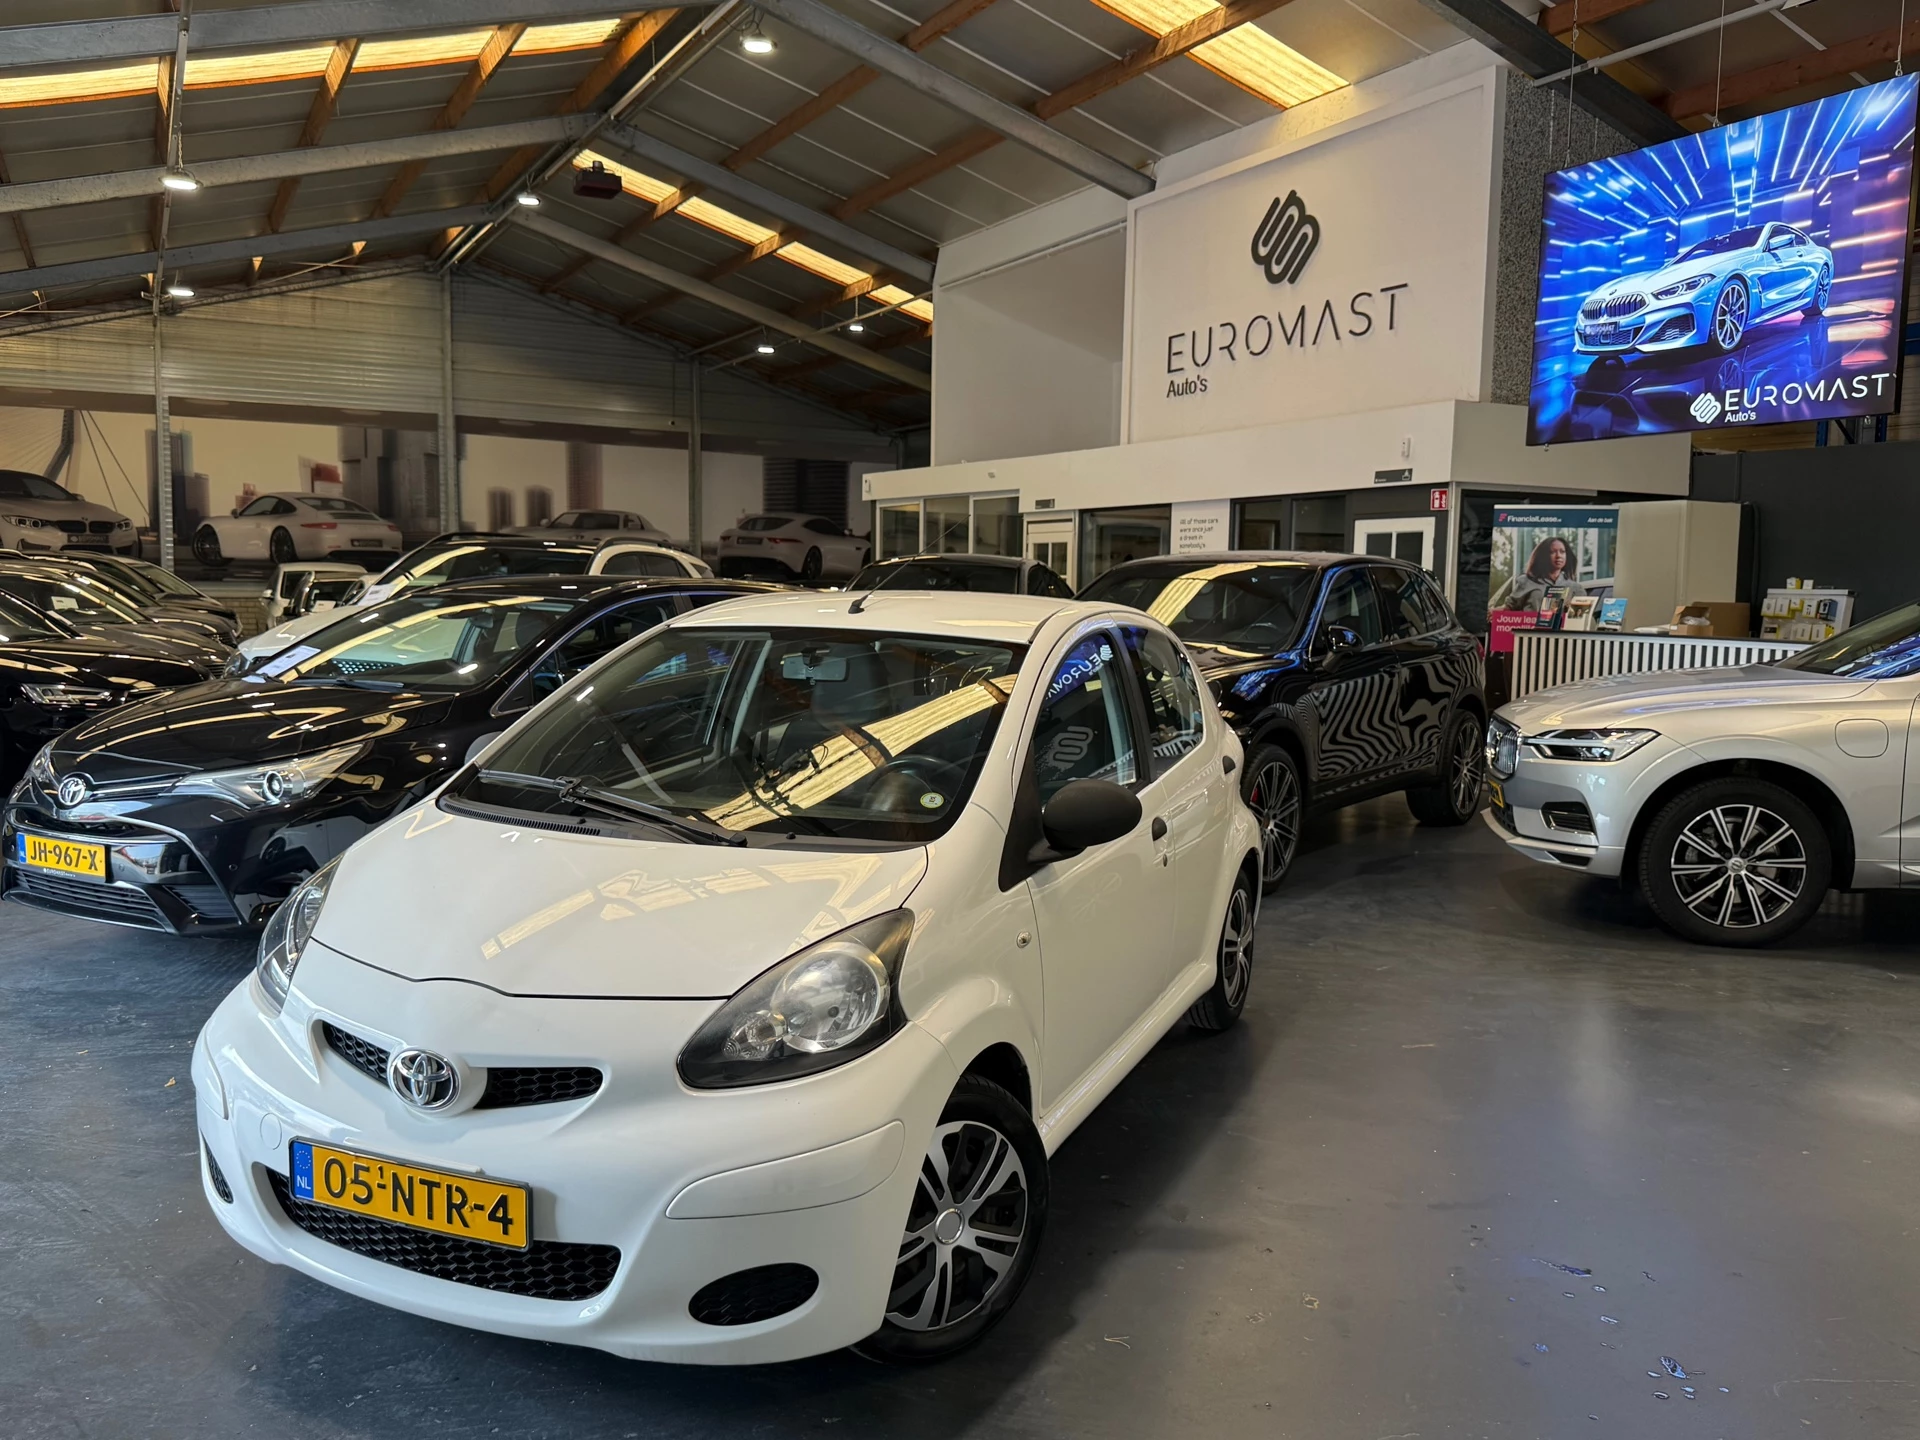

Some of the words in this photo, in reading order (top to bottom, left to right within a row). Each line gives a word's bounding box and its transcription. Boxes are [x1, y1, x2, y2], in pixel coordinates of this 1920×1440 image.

[1167, 283, 1408, 373] EUROMAST
[1166, 374, 1208, 398] Auto's
[1725, 373, 1890, 411] EUROMAST
[1724, 410, 1756, 423] Auto's
[1496, 615, 1522, 623] Jouw
[31, 840, 98, 871] JH-967-X
[296, 1174, 311, 1190] NL
